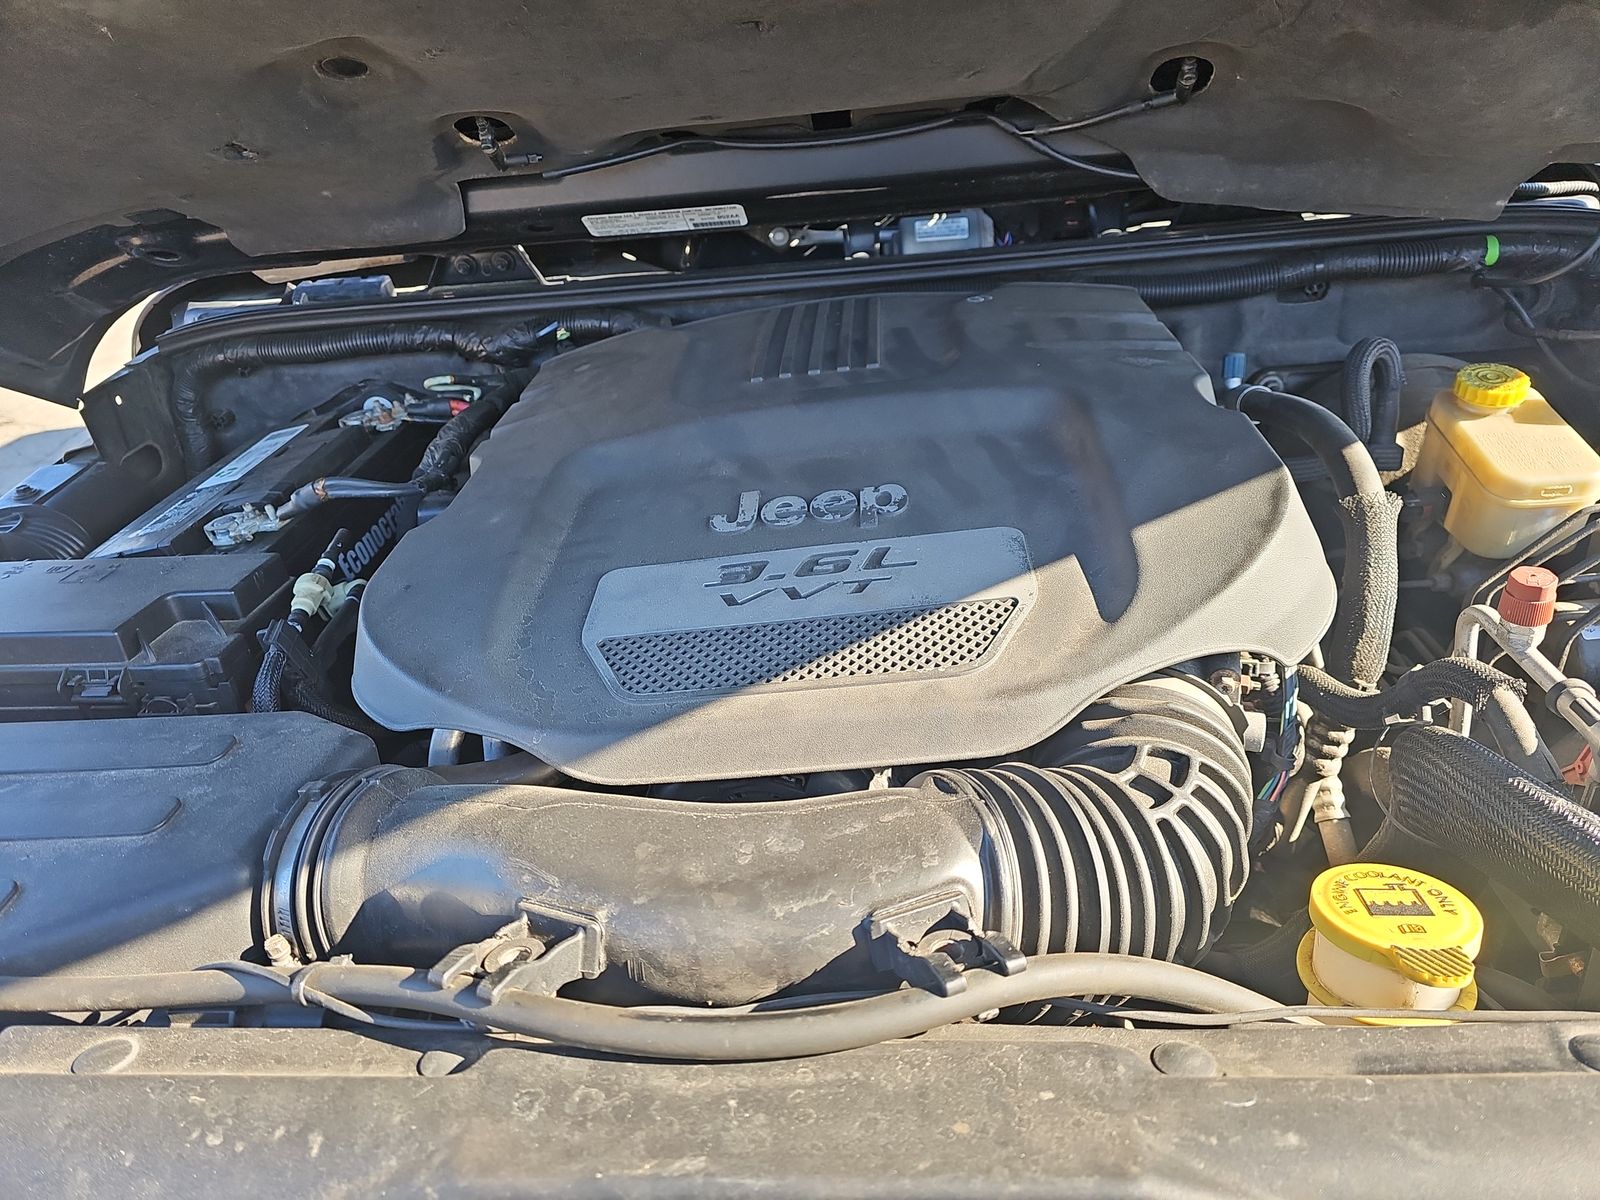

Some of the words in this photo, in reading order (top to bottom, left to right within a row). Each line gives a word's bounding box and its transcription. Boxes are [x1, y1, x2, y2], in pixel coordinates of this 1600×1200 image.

[709, 482, 909, 534] Jeep
[703, 546, 917, 588] 3.6L
[720, 575, 892, 606] VVT
[1330, 877, 1358, 916] ENGINE
[1343, 870, 1426, 888] COOLANT
[1427, 888, 1458, 916] ONLY
